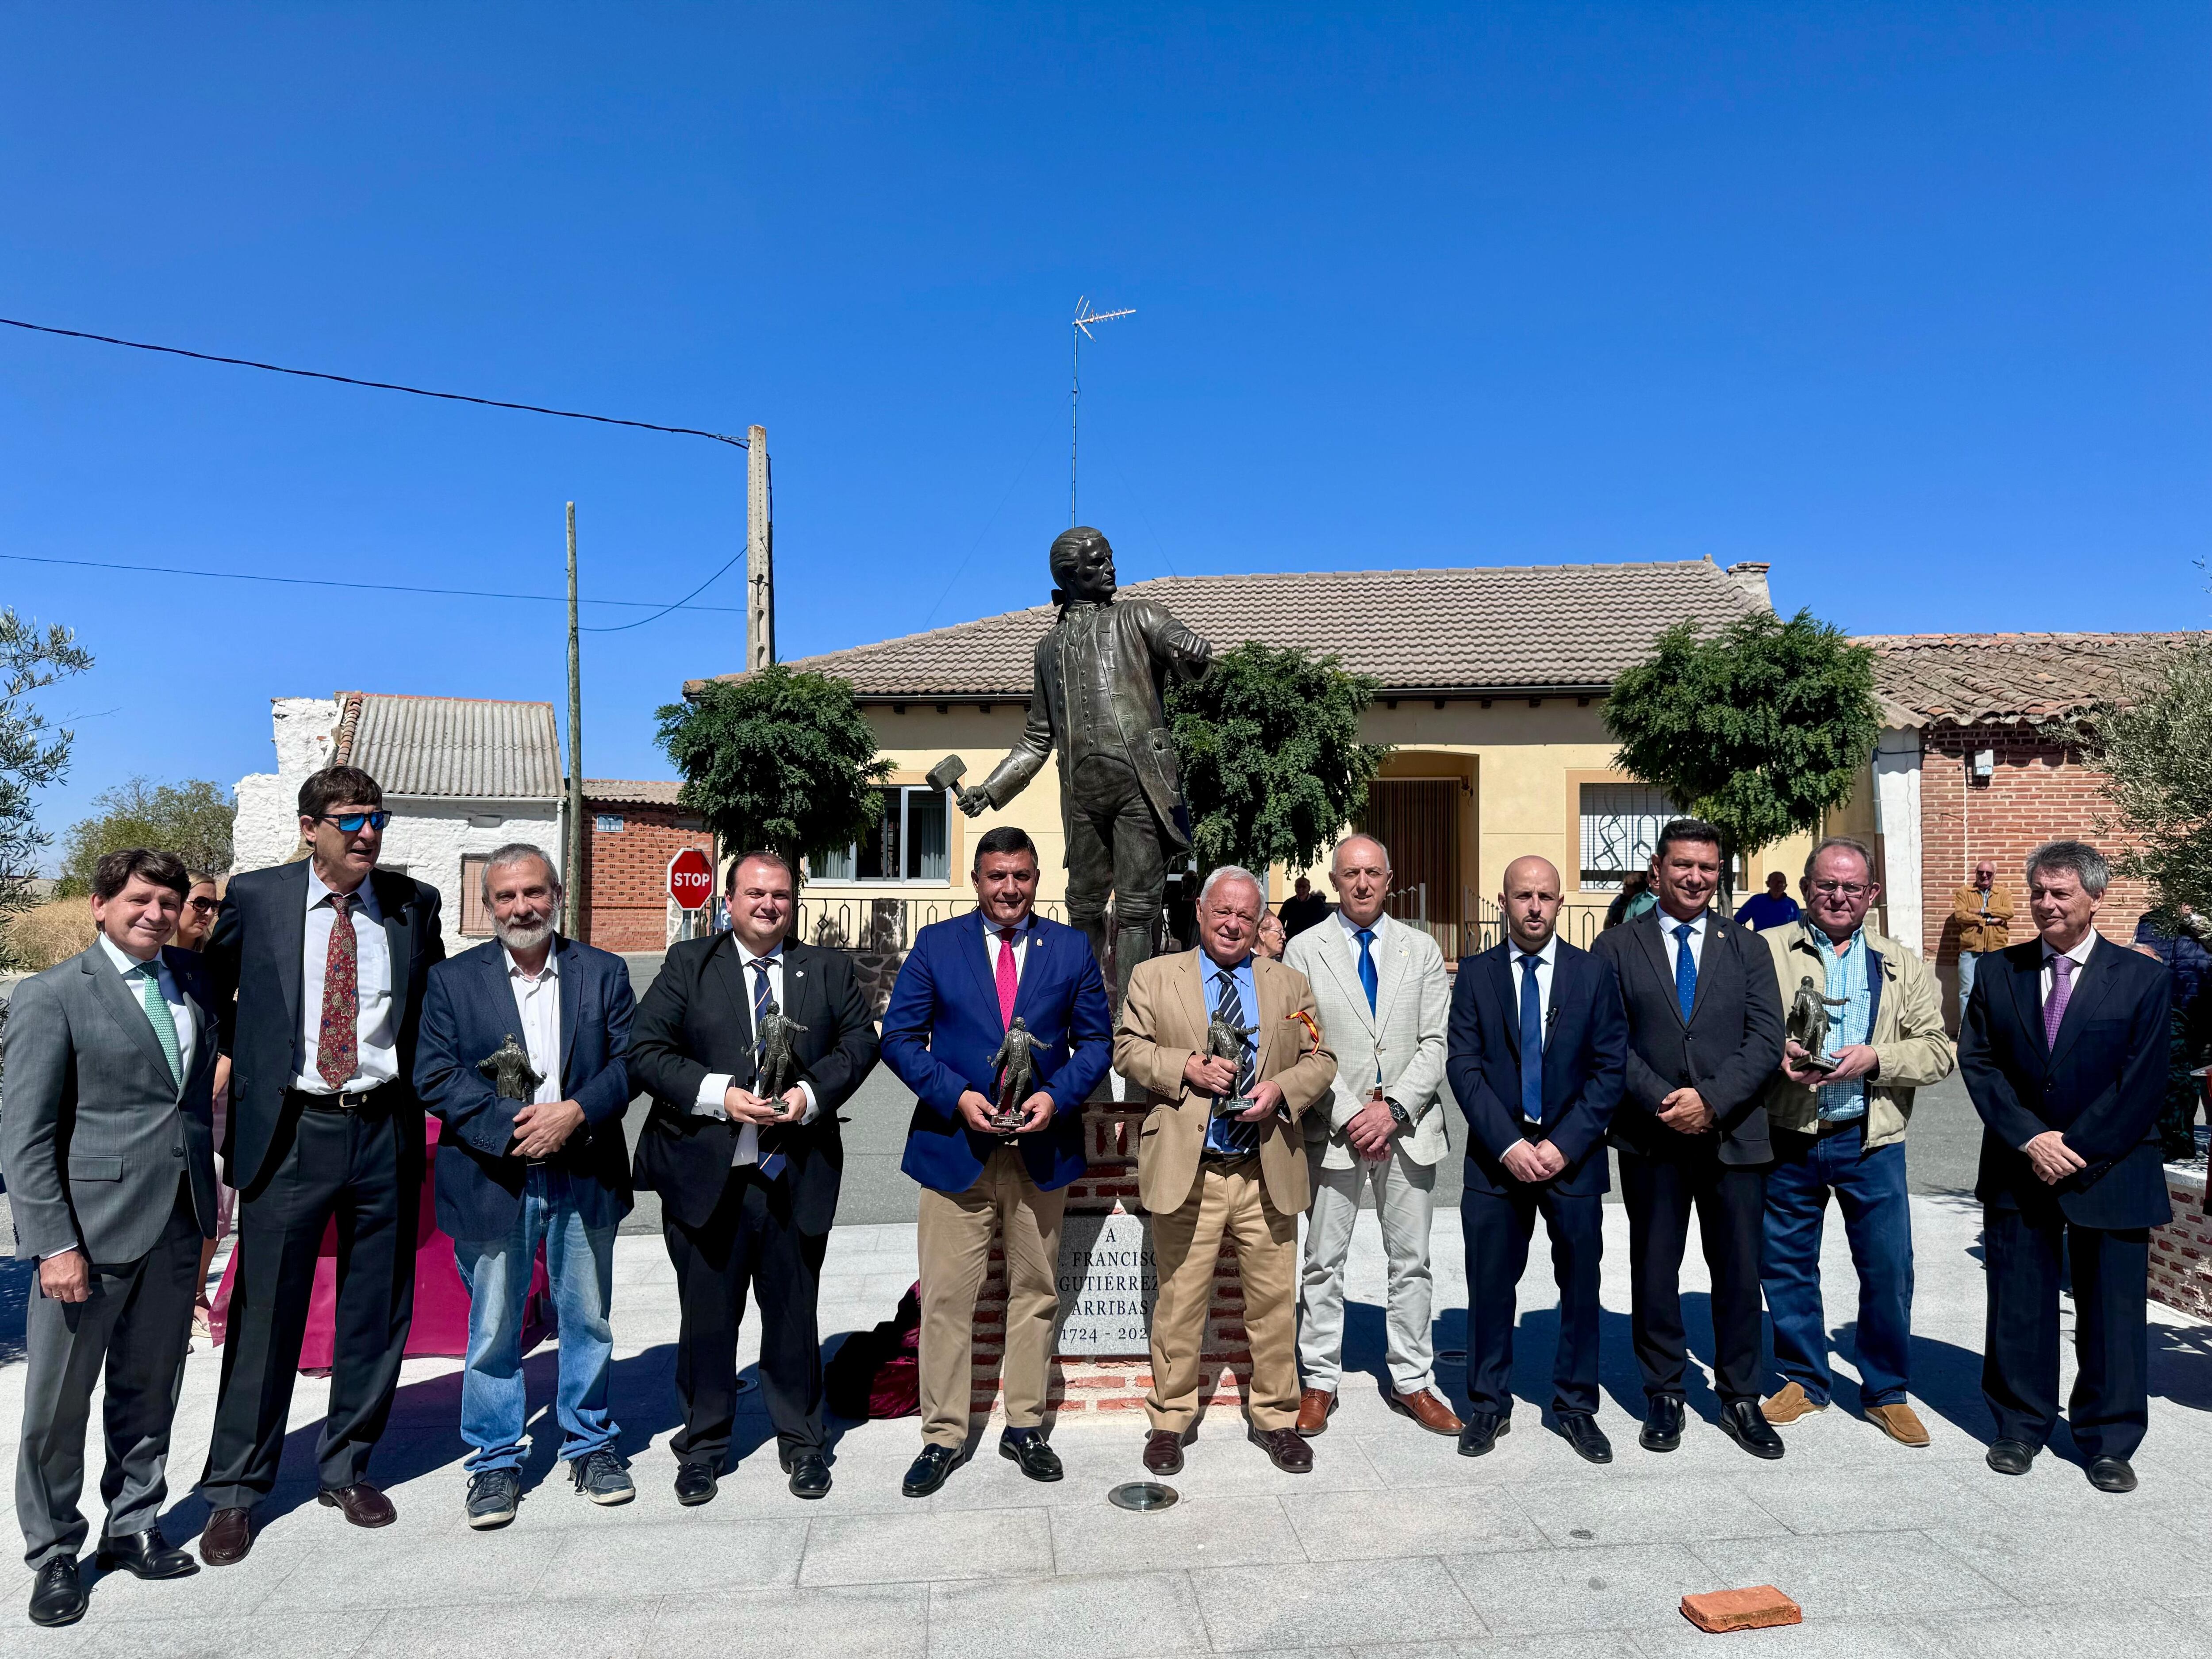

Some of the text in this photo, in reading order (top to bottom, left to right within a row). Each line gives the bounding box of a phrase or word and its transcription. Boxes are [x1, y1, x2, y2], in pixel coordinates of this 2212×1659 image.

[674, 872, 710, 887] STOP
[1106, 1228, 1116, 1242] A
[1059, 1272, 1157, 1291] GUTIÉRREZ
[1071, 1300, 1148, 1315] ARRIBAS
[1061, 1328, 1098, 1343] 1724
[1118, 1328, 1150, 1340] 202
